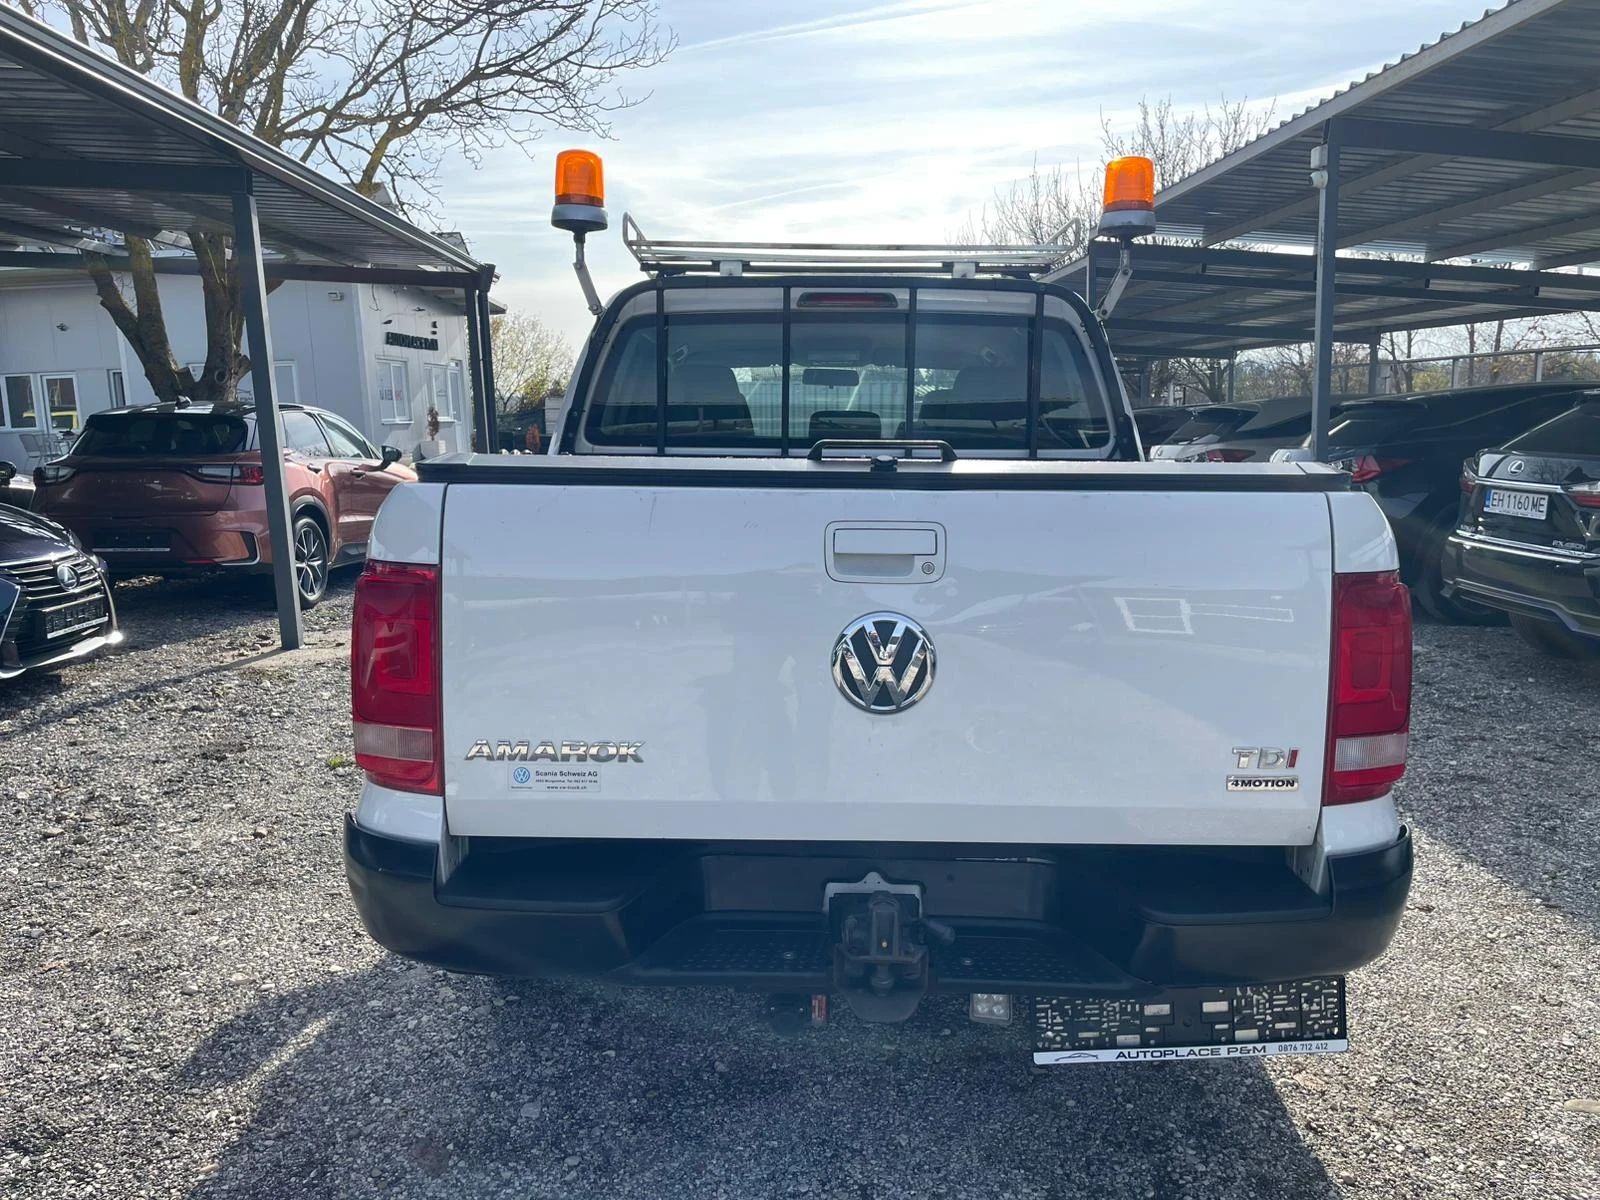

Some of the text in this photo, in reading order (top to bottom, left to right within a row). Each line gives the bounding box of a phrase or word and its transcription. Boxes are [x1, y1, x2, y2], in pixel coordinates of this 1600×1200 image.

[1491, 491, 1504, 508] EH
[1507, 494, 1529, 510] 1160
[1531, 496, 1546, 513] ME
[464, 739, 646, 763] AMAROK
[1232, 746, 1300, 769] TDI
[1231, 779, 1295, 788] 4MOTION
[1115, 1042, 1329, 1060] AUTOPLACE P&M 0876 712 412
